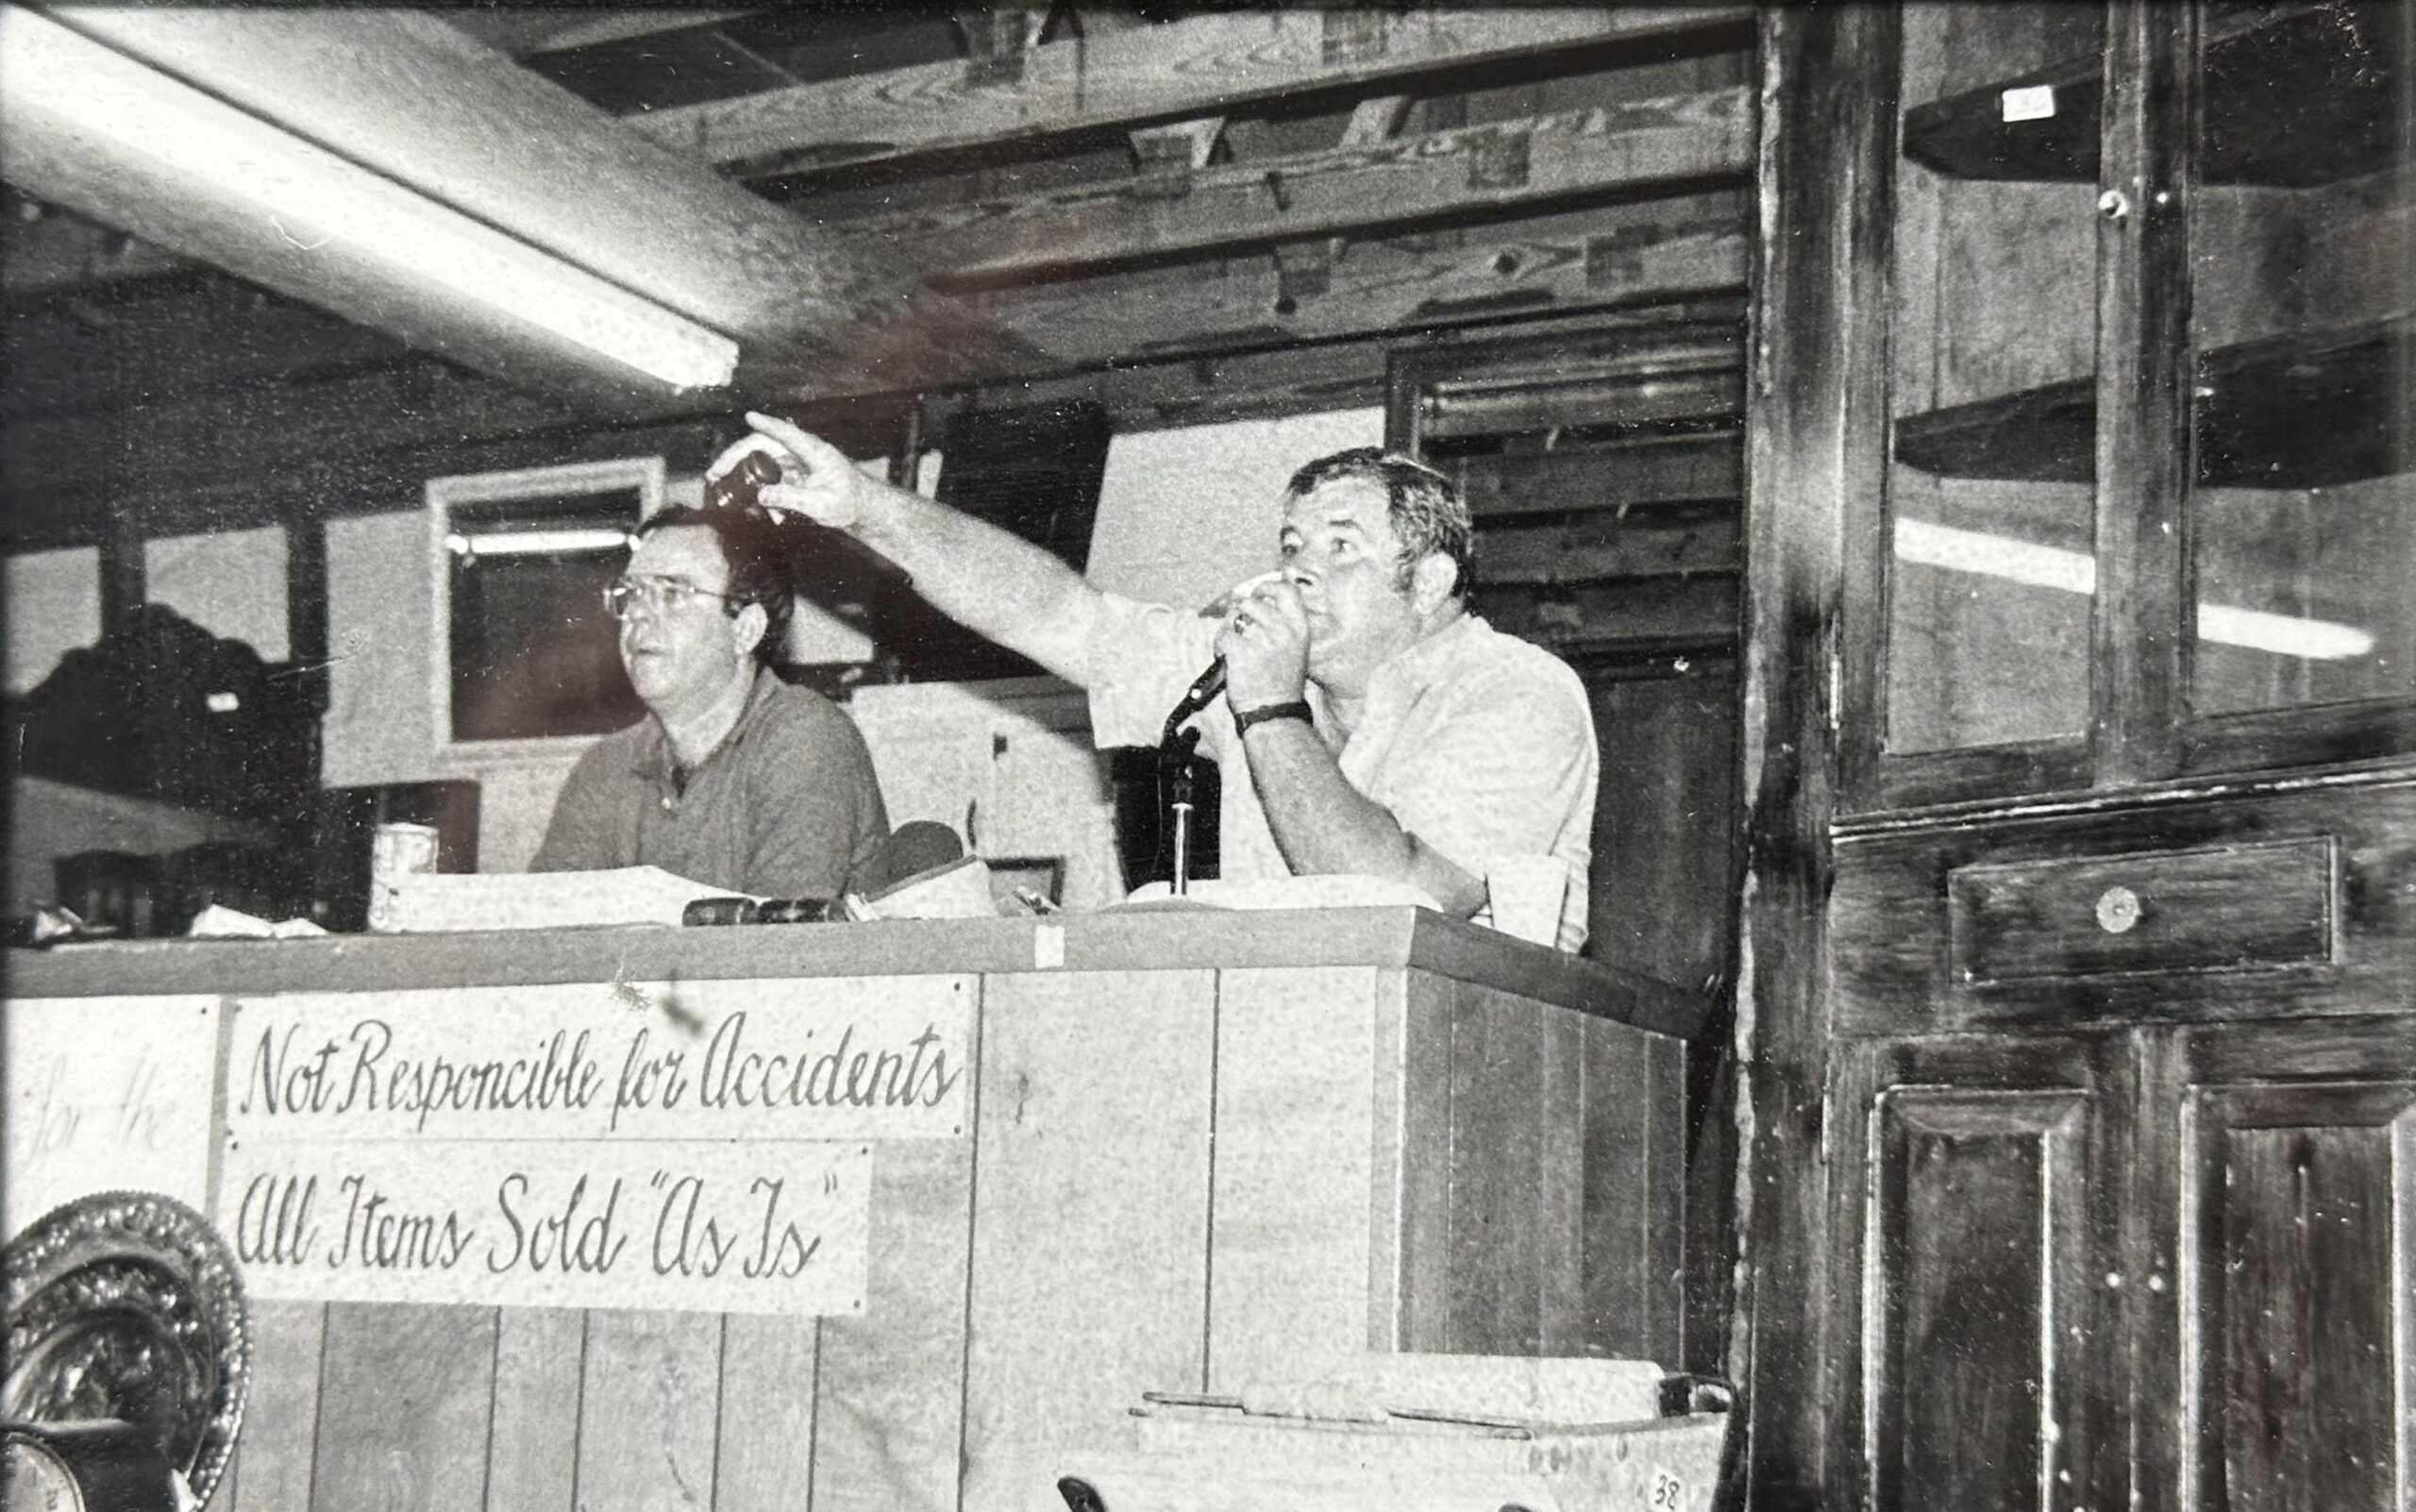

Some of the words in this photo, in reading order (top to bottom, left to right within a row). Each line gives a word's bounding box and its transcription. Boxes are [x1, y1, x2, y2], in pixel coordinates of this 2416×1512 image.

[242, 1022, 340, 1116] Not
[337, 1019, 604, 1132] Responcible
[611, 1027, 689, 1132] for
[699, 1011, 964, 1110] Accidents
[238, 1172, 319, 1266] All
[328, 1174, 475, 1271] Items
[487, 1172, 629, 1274] Sold
[649, 1168, 738, 1278] "As
[1654, 1473, 1680, 1510] 38
